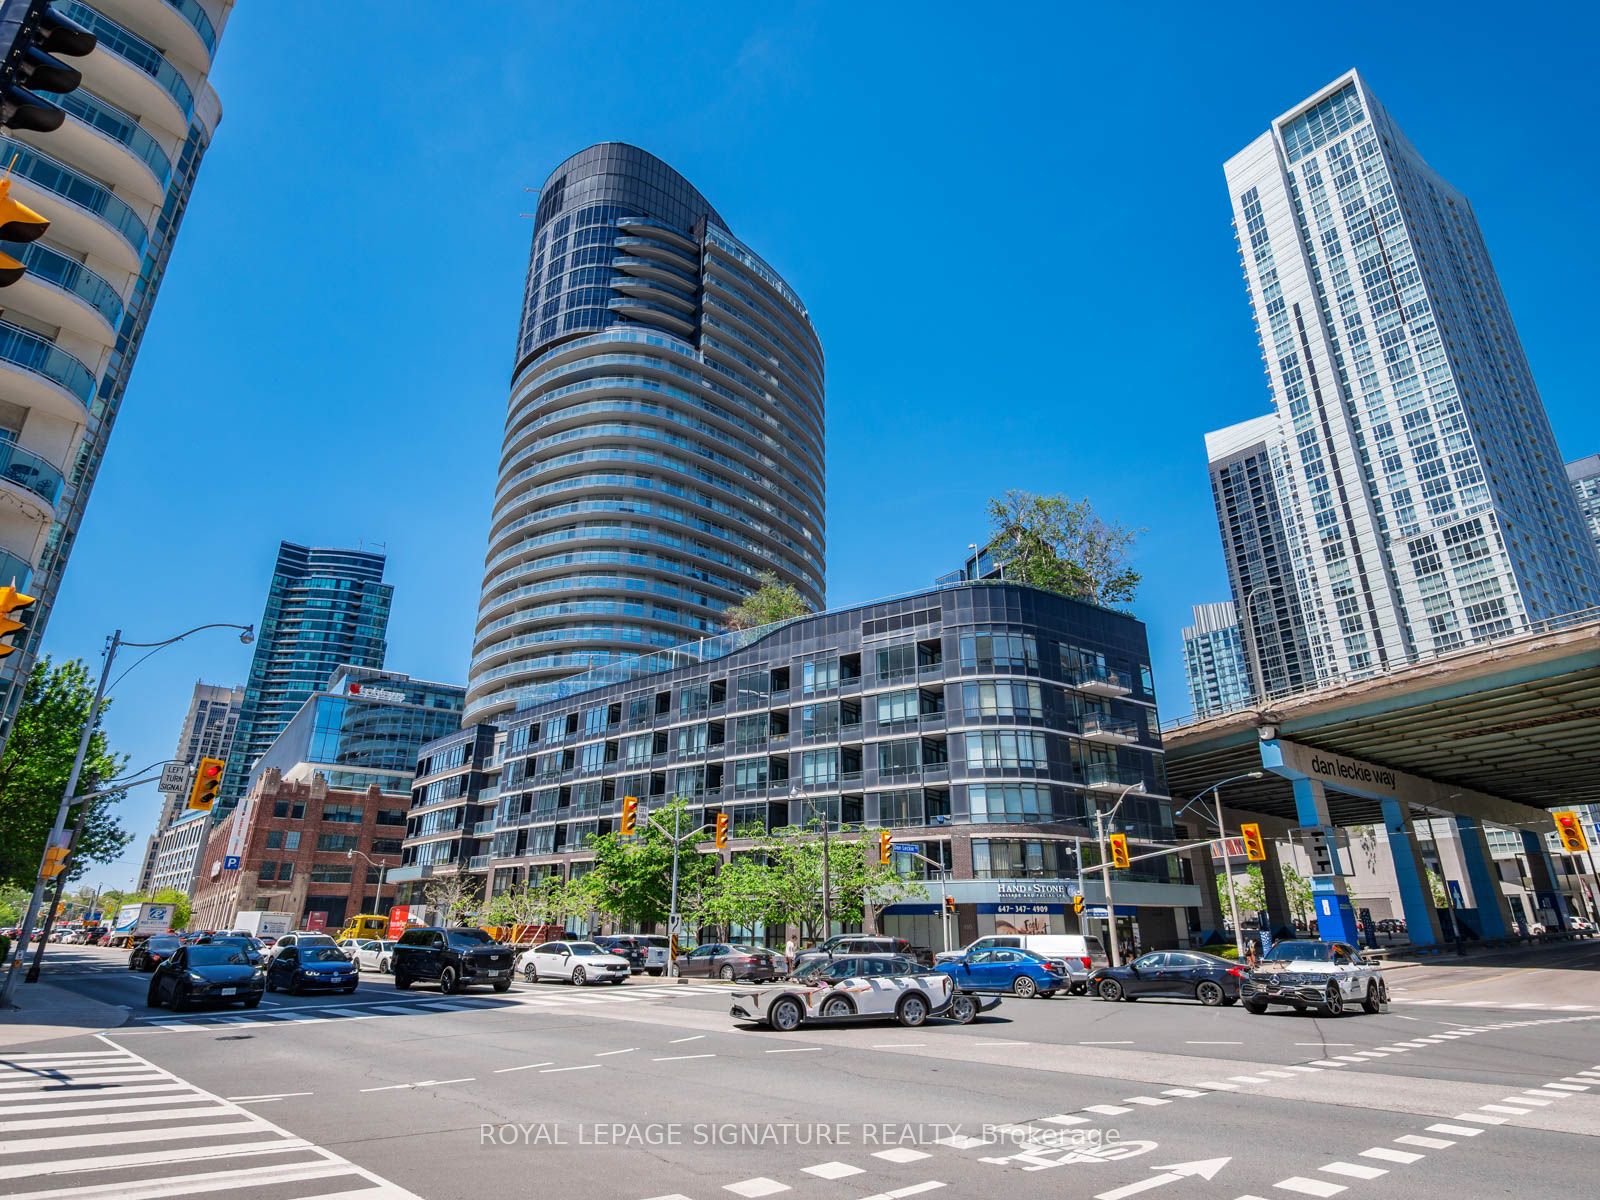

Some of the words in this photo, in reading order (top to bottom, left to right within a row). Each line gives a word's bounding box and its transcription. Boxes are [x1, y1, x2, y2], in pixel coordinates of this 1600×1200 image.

[1312, 755, 1336, 777] dan
[1336, 759, 1371, 782] leckie
[1372, 769, 1395, 790] way
[160, 783, 183, 791] SIGNAL
[227, 857, 237, 868] P
[998, 883, 1027, 893] HAND
[1033, 883, 1065, 893] STONE
